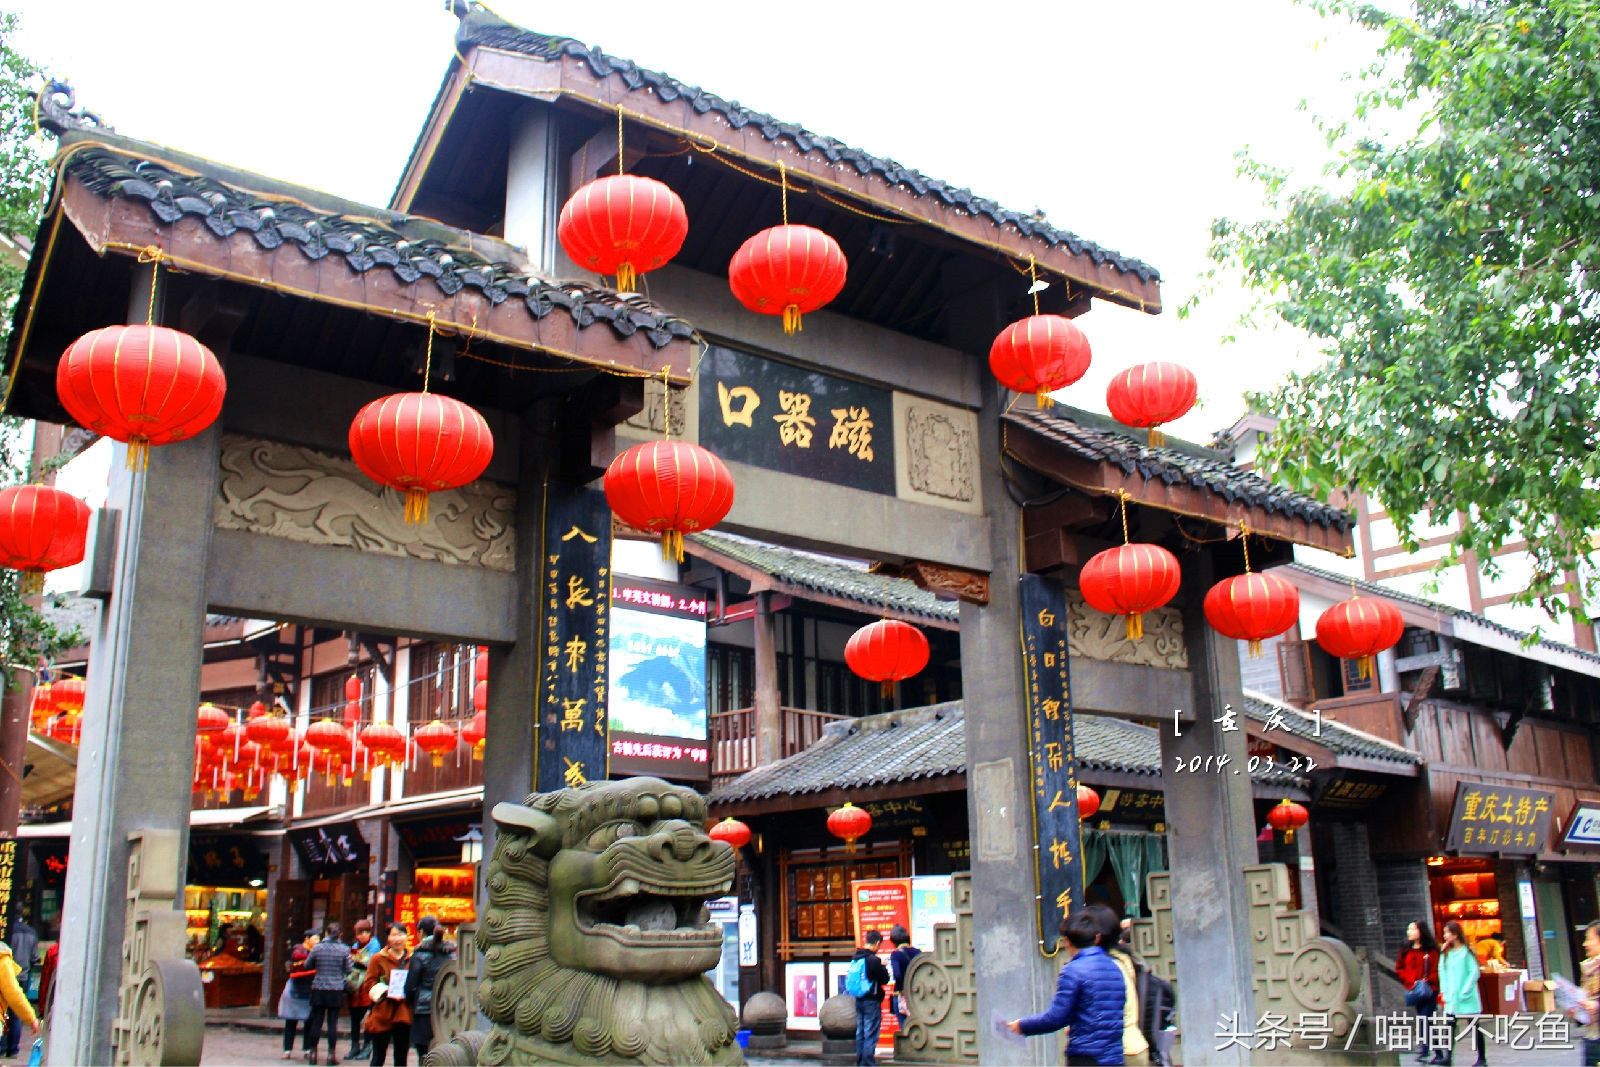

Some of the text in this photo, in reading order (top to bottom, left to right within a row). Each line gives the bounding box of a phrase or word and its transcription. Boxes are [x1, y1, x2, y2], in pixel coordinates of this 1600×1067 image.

[1462, 791, 1549, 826] 重庆土特产
